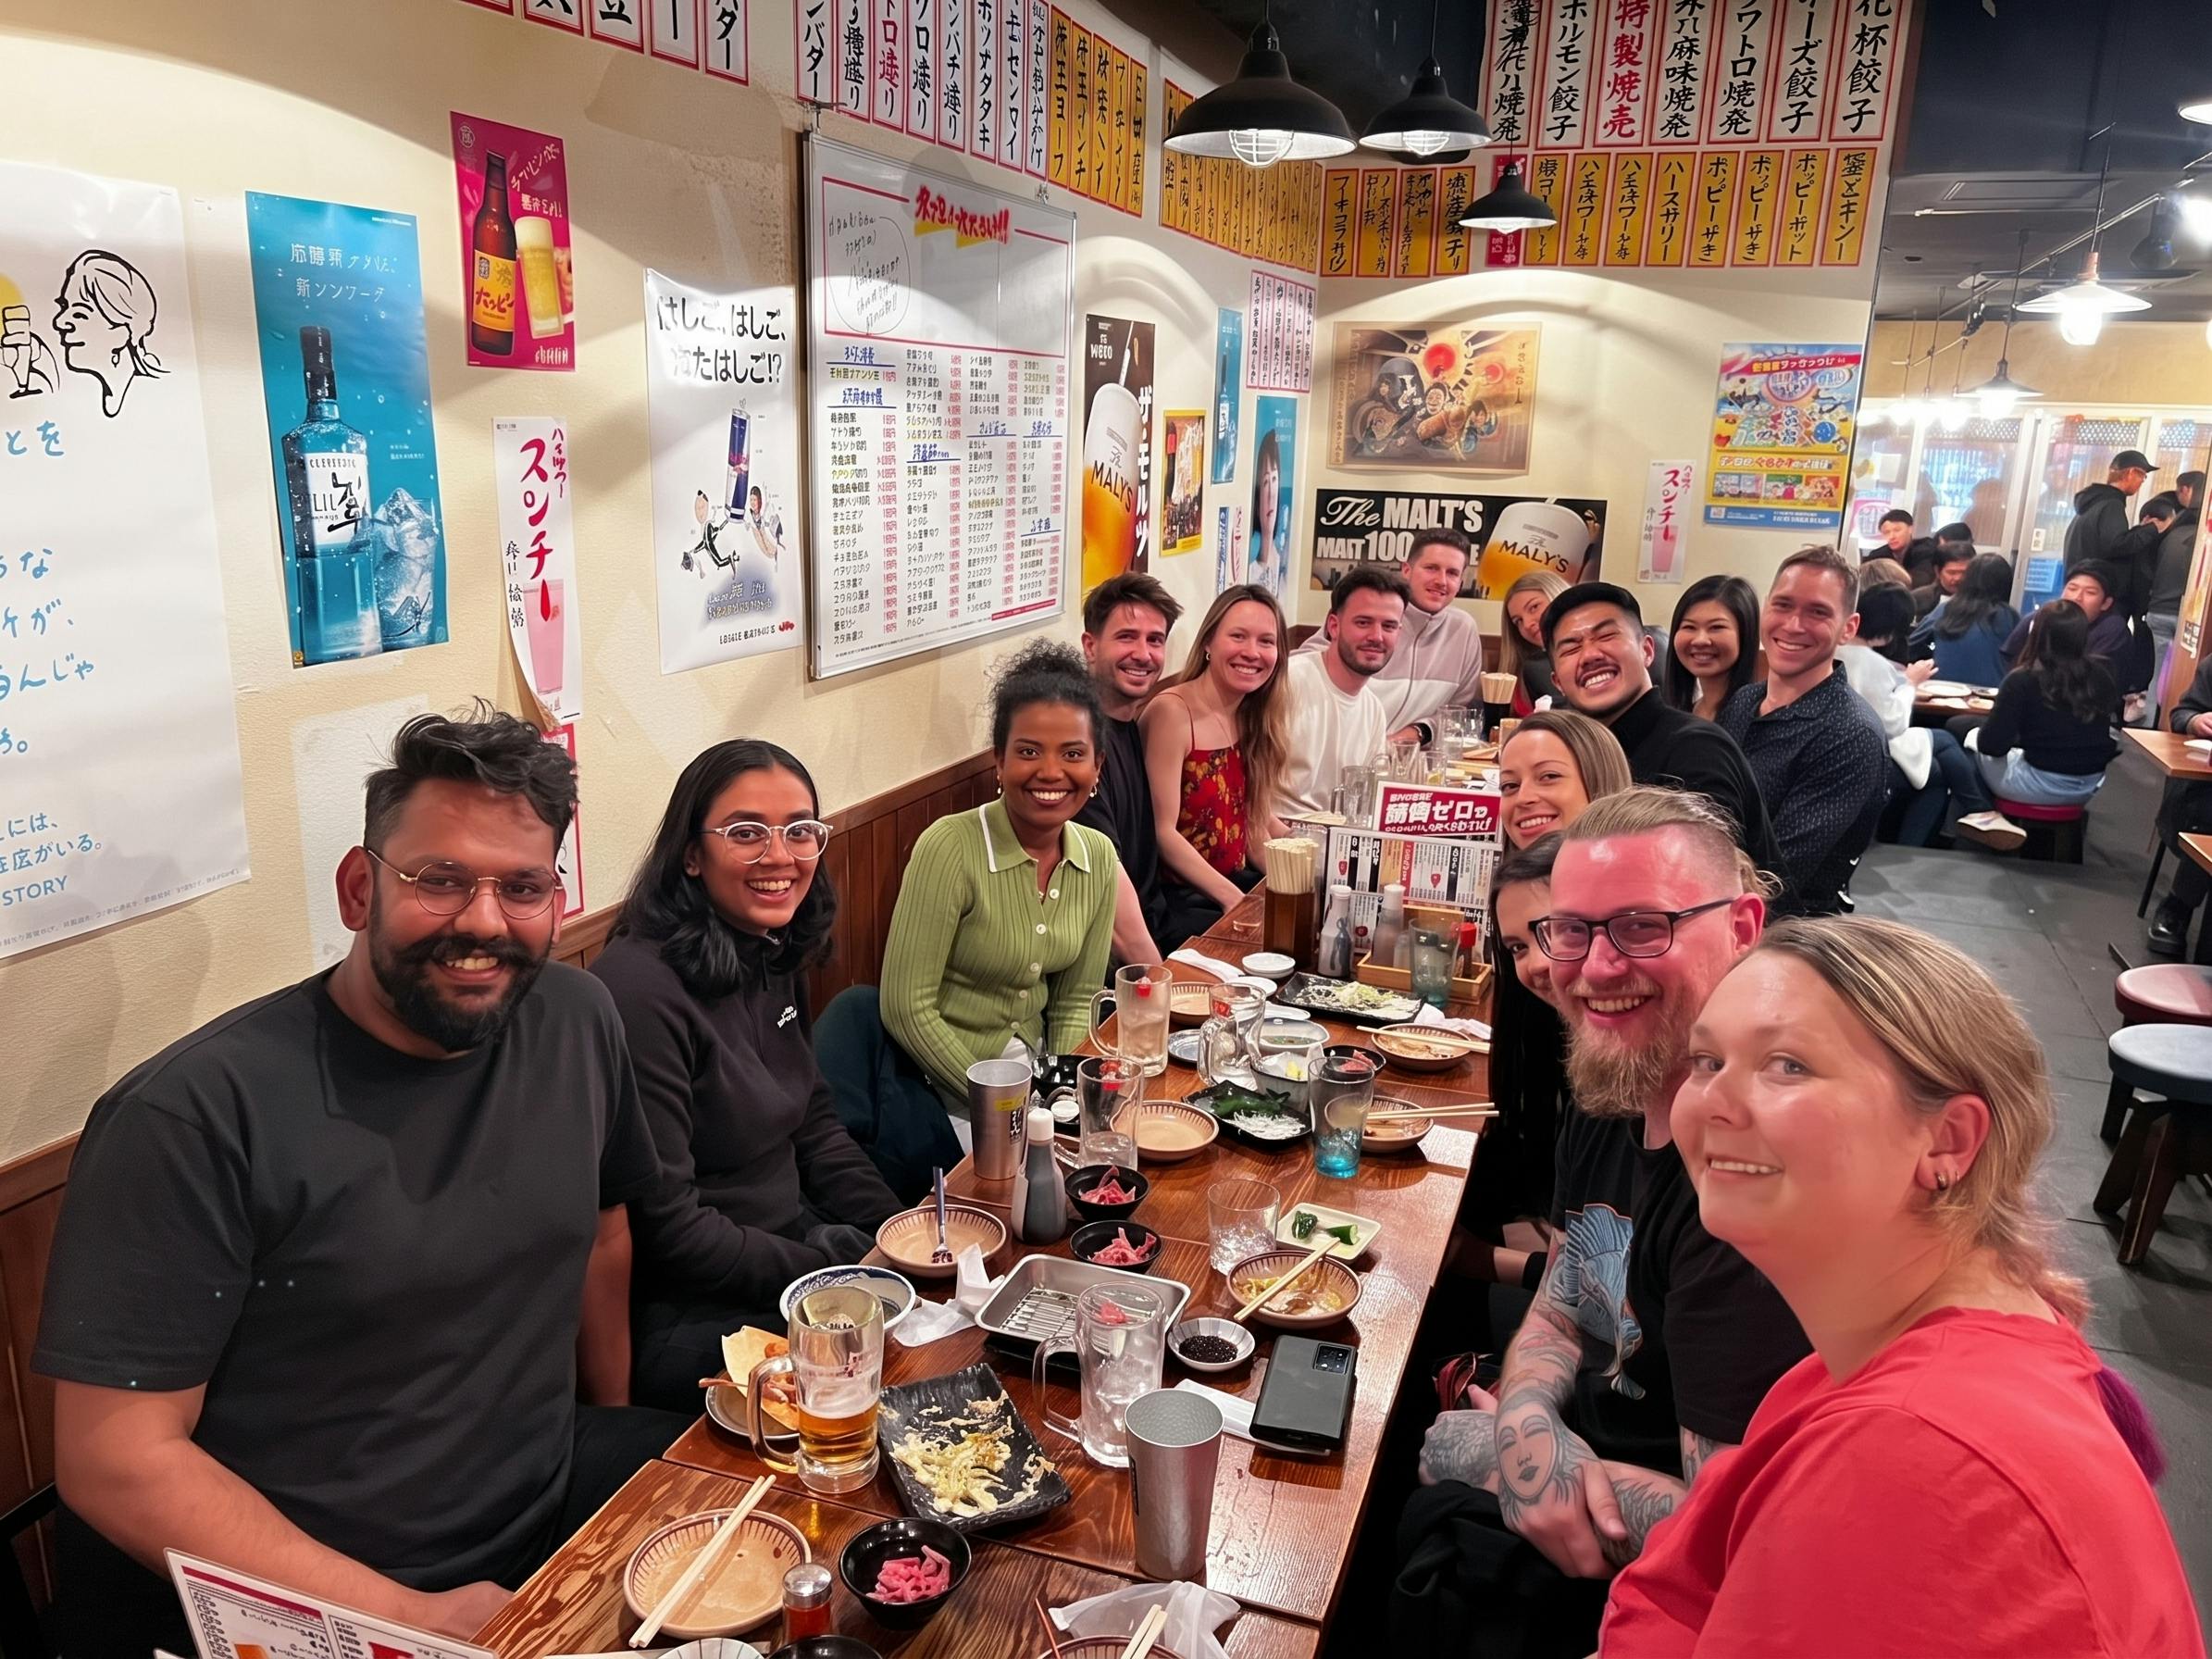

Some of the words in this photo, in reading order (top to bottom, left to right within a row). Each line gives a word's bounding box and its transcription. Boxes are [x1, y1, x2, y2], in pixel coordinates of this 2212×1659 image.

[1546, 0, 1587, 141] ホルモン餃子
[1602, 0, 1651, 139] 特製焼売
[1719, 0, 1763, 136] ワトロ焼発
[1320, 496, 1381, 527] The
[1383, 497, 1484, 533] MALT'S
[0, 812, 58, 841] には、
[2, 875, 68, 907] STORY
